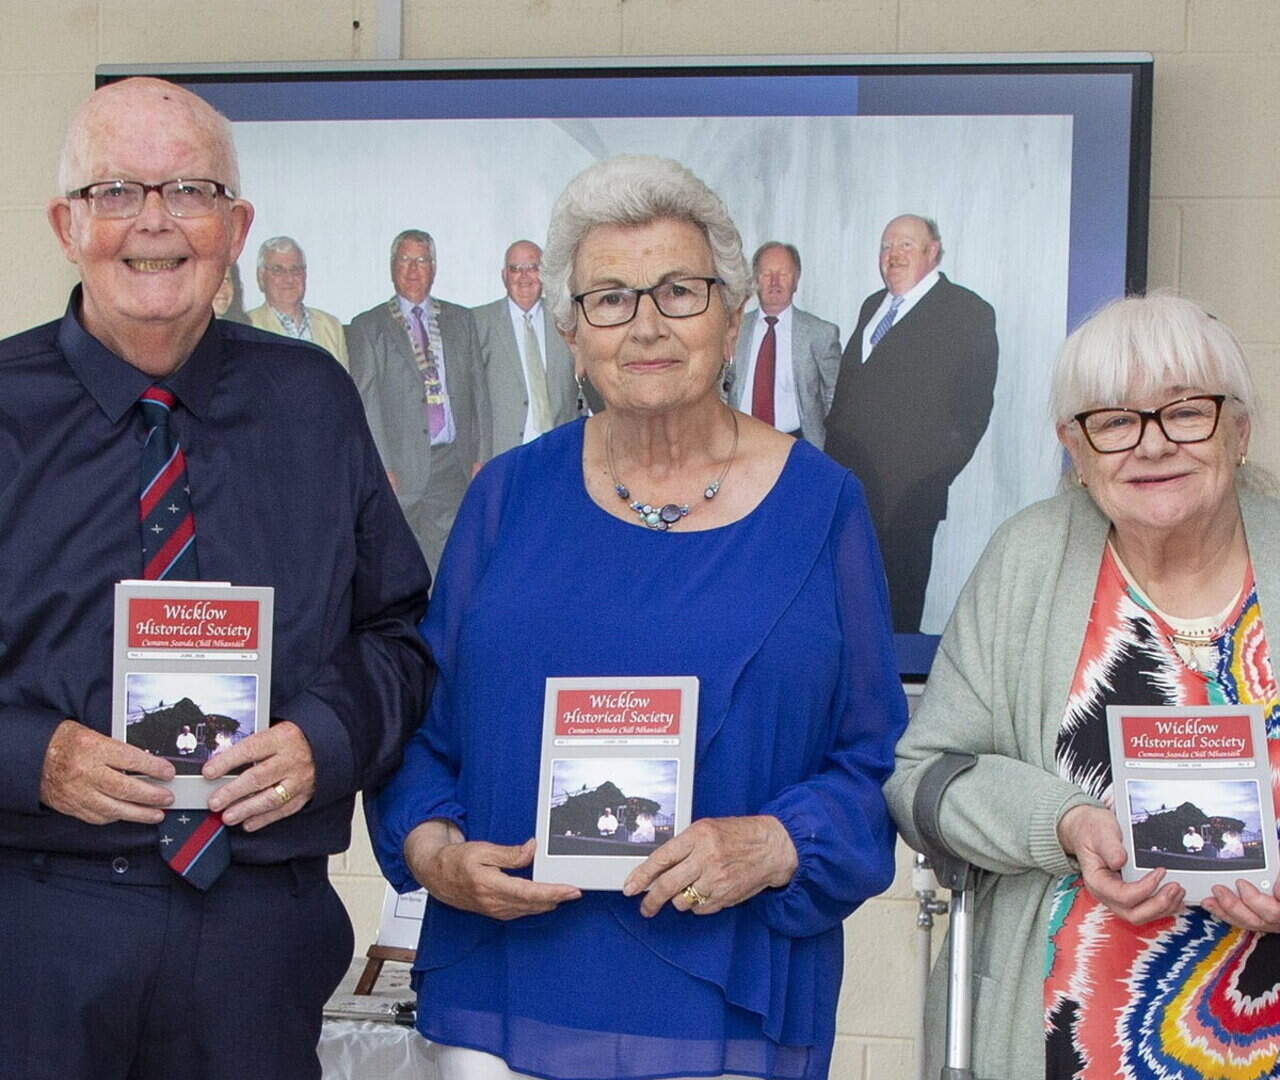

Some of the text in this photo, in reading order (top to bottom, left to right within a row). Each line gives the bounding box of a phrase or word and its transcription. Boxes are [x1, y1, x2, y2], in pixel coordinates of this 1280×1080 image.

[163, 601, 227, 620] Wicklow
[135, 618, 252, 644] Historical Society
[589, 691, 651, 709] Wicklow
[563, 706, 674, 730] Historical Society
[1154, 718, 1219, 735] Wicklow
[1130, 732, 1246, 754] Historical Society
